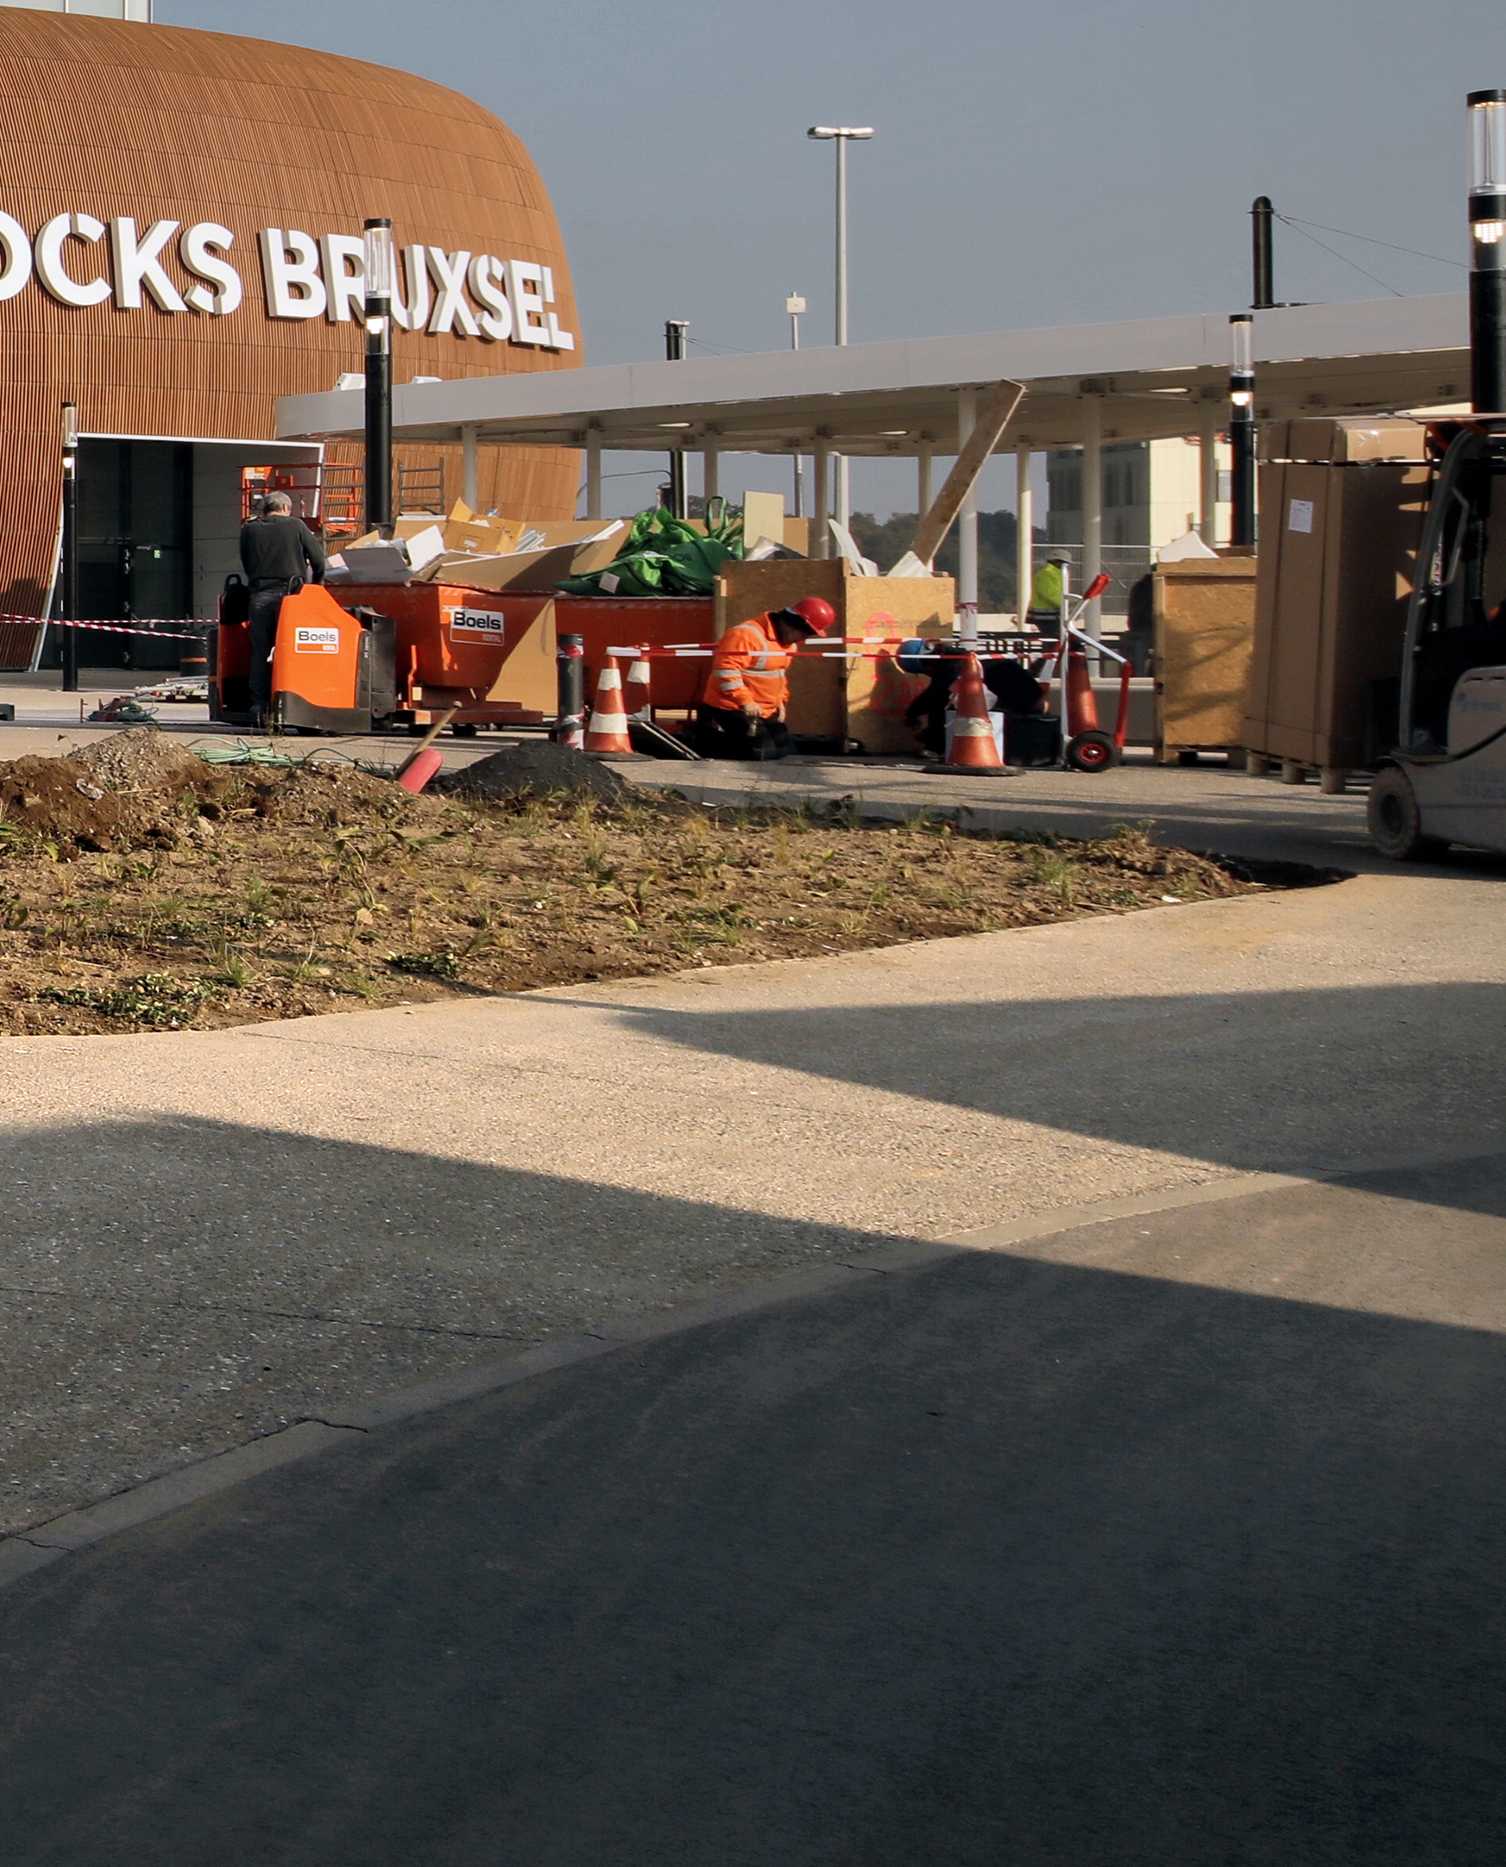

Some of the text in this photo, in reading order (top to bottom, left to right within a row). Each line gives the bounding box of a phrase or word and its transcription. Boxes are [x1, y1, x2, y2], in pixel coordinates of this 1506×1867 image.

[260, 227, 575, 350] BRUXSEL
[453, 611, 501, 630] Boels
[298, 631, 336, 642] Boels
